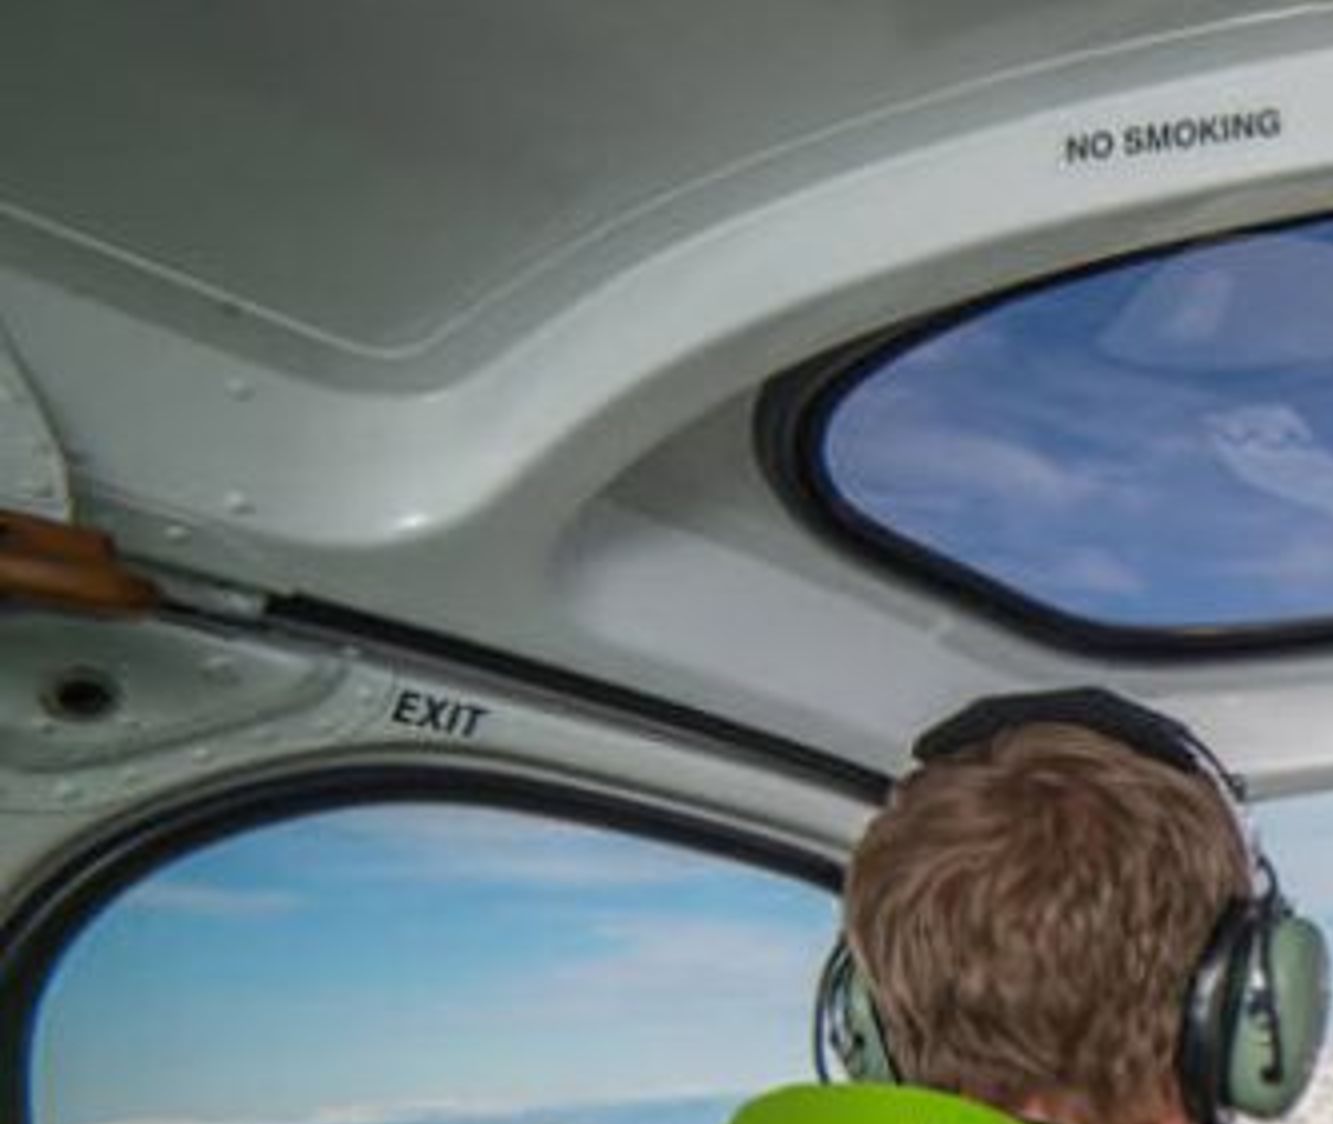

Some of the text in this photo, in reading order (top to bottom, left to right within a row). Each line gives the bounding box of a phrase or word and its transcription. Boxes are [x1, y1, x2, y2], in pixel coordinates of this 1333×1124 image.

[1064, 107, 1282, 163] NO SMOKING
[392, 690, 490, 737] EXIT
